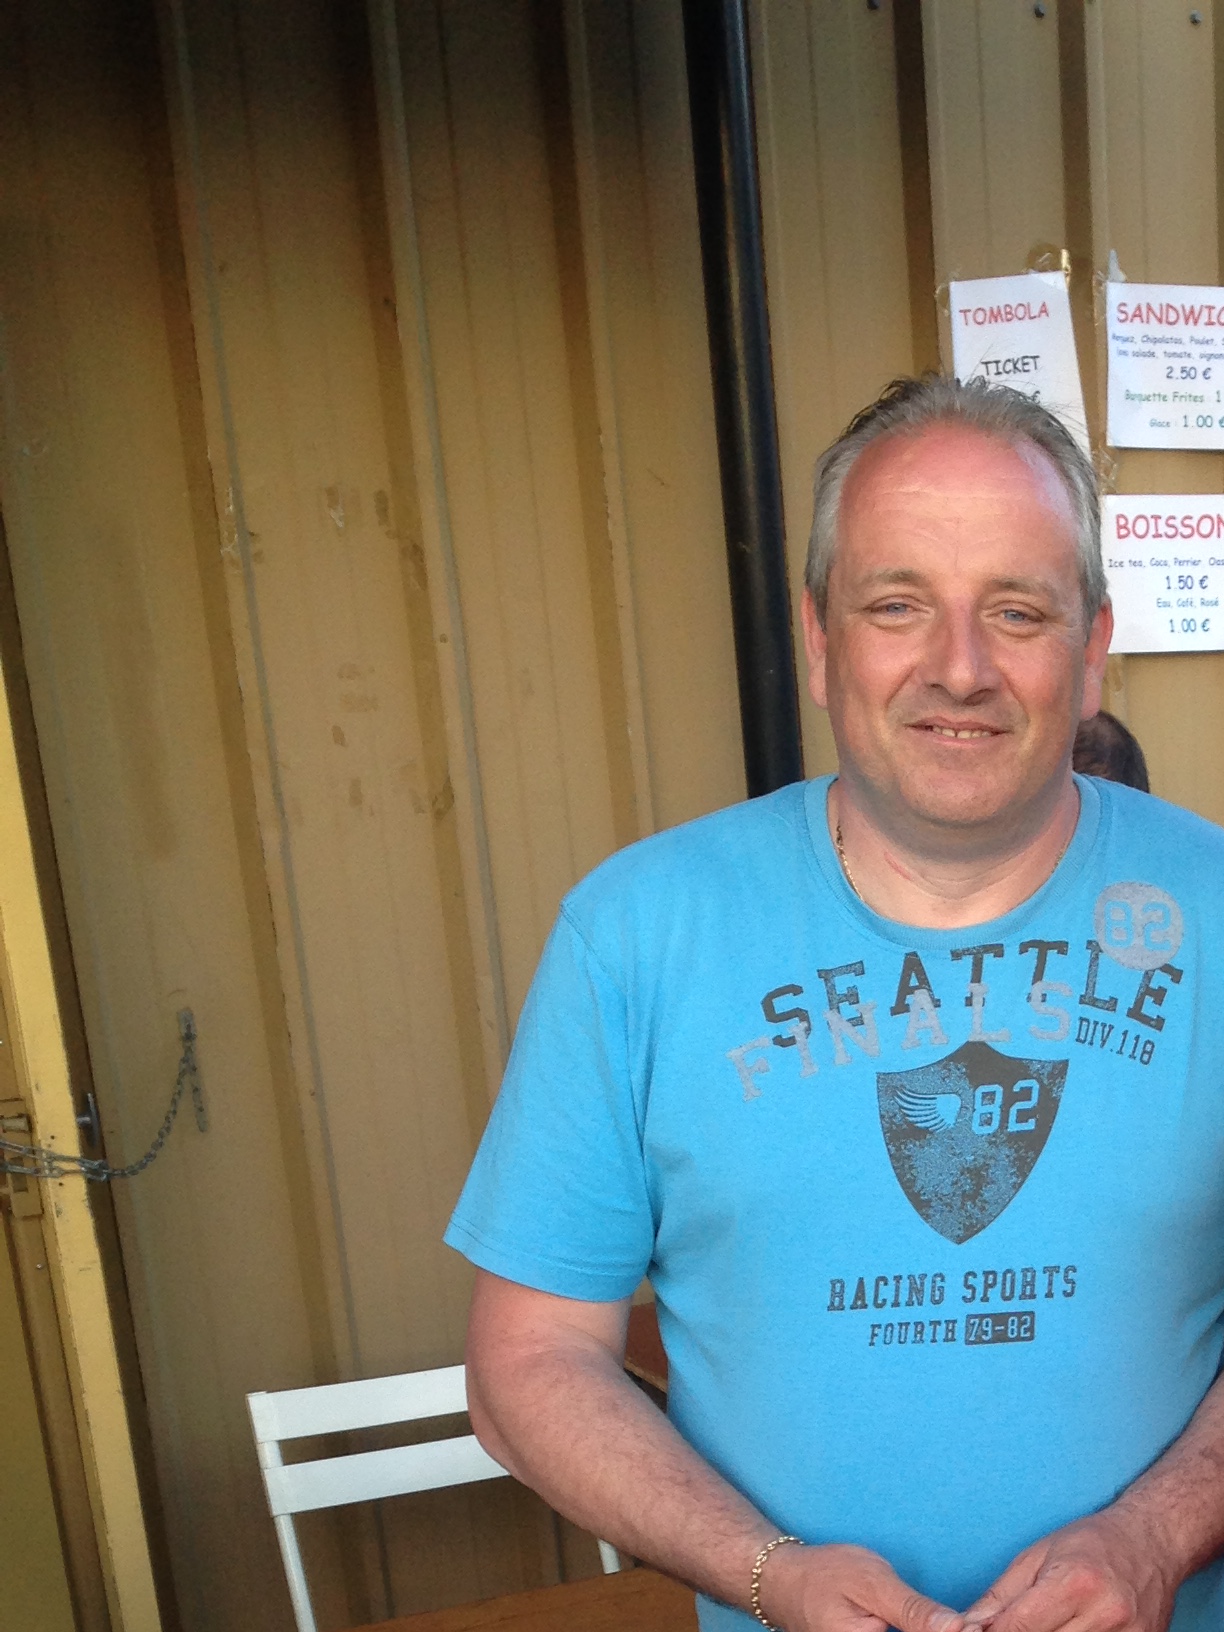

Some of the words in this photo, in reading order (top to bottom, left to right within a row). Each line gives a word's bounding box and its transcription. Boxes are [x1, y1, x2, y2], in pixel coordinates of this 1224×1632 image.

[959, 302, 1049, 326] TOMBOLA
[981, 355, 1040, 376] TICKET
[1166, 366, 1197, 380] 2.50
[1202, 367, 1211, 380] €
[1172, 391, 1204, 403] Frites
[1149, 418, 1171, 428] Glace
[1183, 415, 1214, 428] 1.00
[1108, 558, 1124, 568] Ice
[1166, 575, 1194, 590] 1.50
[1199, 575, 1208, 590] €
[1169, 618, 1197, 633] 1.00
[1201, 618, 1210, 633] €
[1104, 900, 1171, 952] 82
[761, 938, 1184, 1048] SEATTLE
[725, 980, 1075, 1102] FINALS
[1075, 1015, 1156, 1066] DIV.118
[971, 1078, 1040, 1135] 82
[827, 1270, 946, 1312] RACING
[962, 1264, 1079, 1304] SPORTS
[868, 1319, 957, 1347] FOURTH
[967, 1314, 1034, 1344] 79-82
